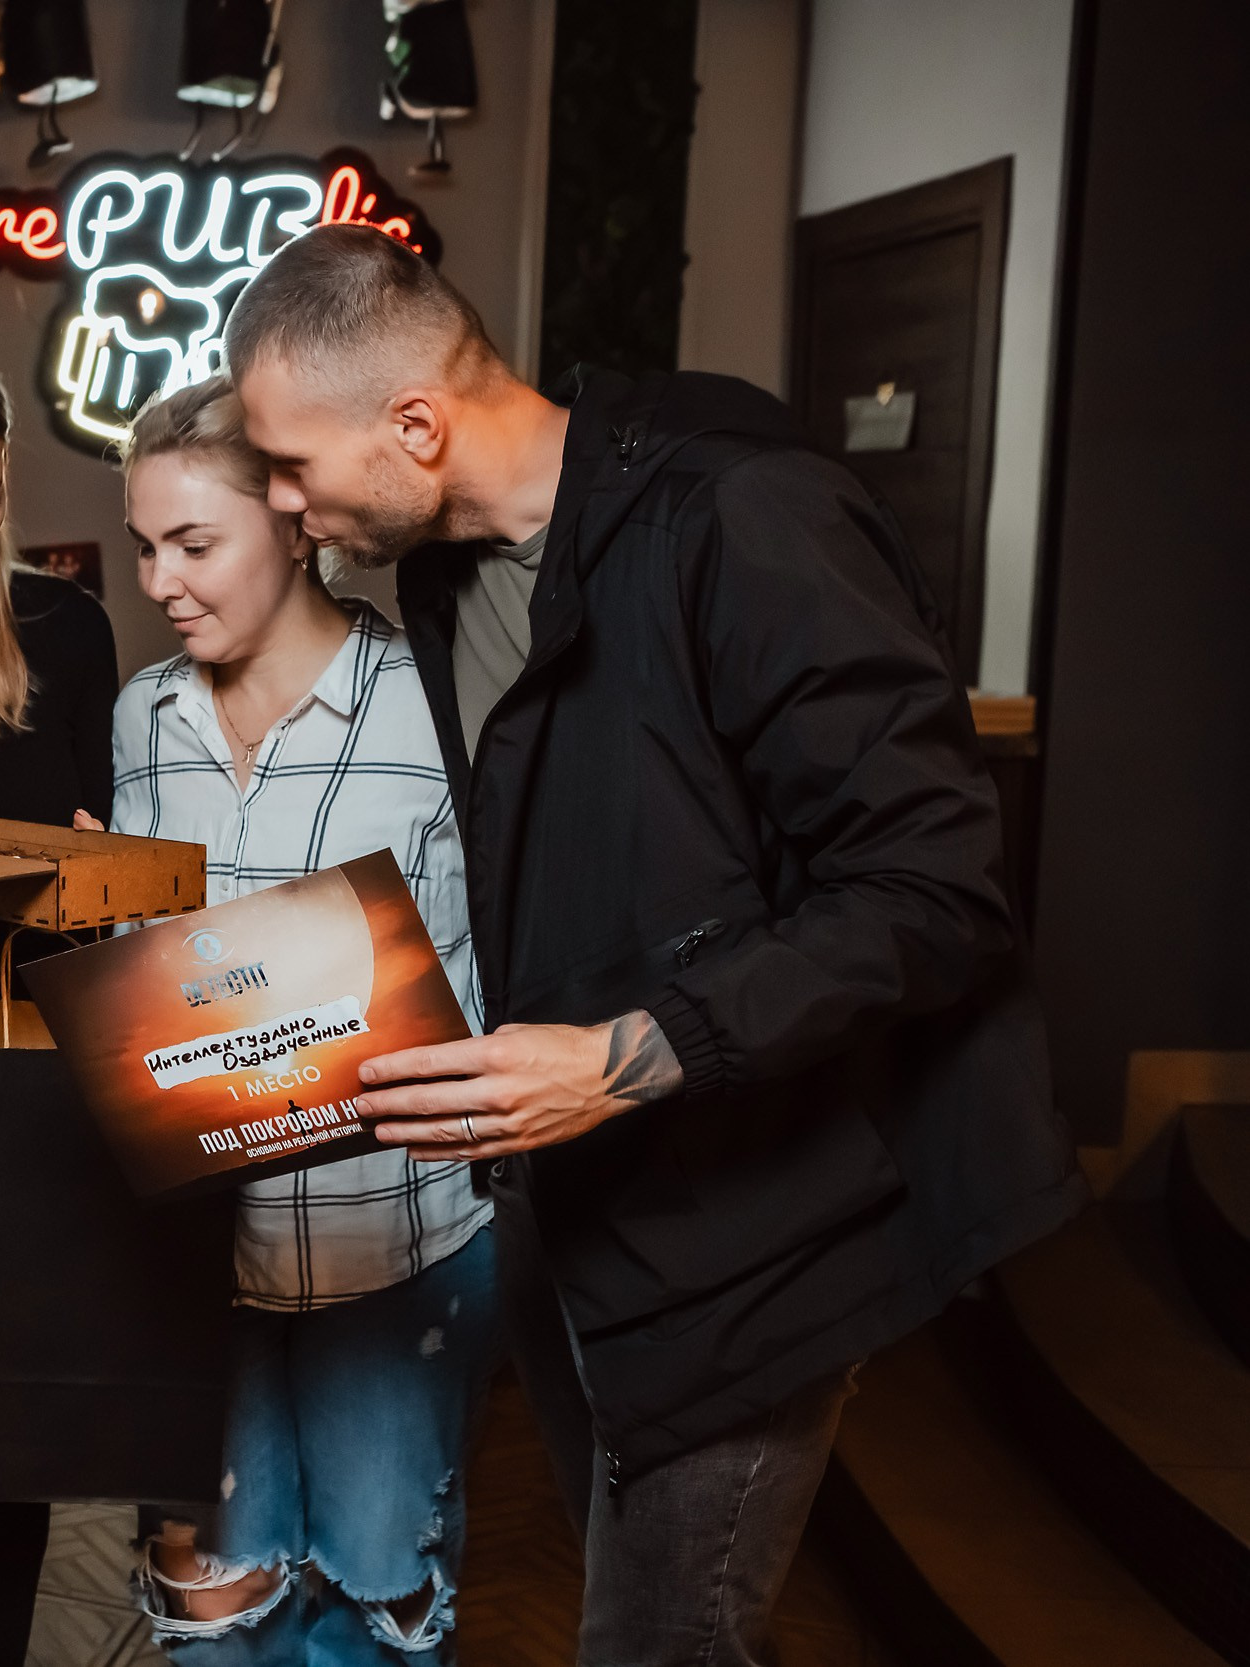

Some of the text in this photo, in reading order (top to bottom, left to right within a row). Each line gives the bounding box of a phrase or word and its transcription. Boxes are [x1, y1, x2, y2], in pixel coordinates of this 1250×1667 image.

[180, 961, 269, 1008] DETECTIT
[148, 1016, 316, 1072] Интеллектуально
[222, 1018, 360, 1071] Озадаченные
[227, 1065, 321, 1101] 1 МЕСТО
[198, 1096, 359, 1155] ПОД ПОКРОВОМ Н
[246, 1123, 363, 1158] ОСНОВАНО НА РЕАЛЬНОЙ ИСТОРИИ
